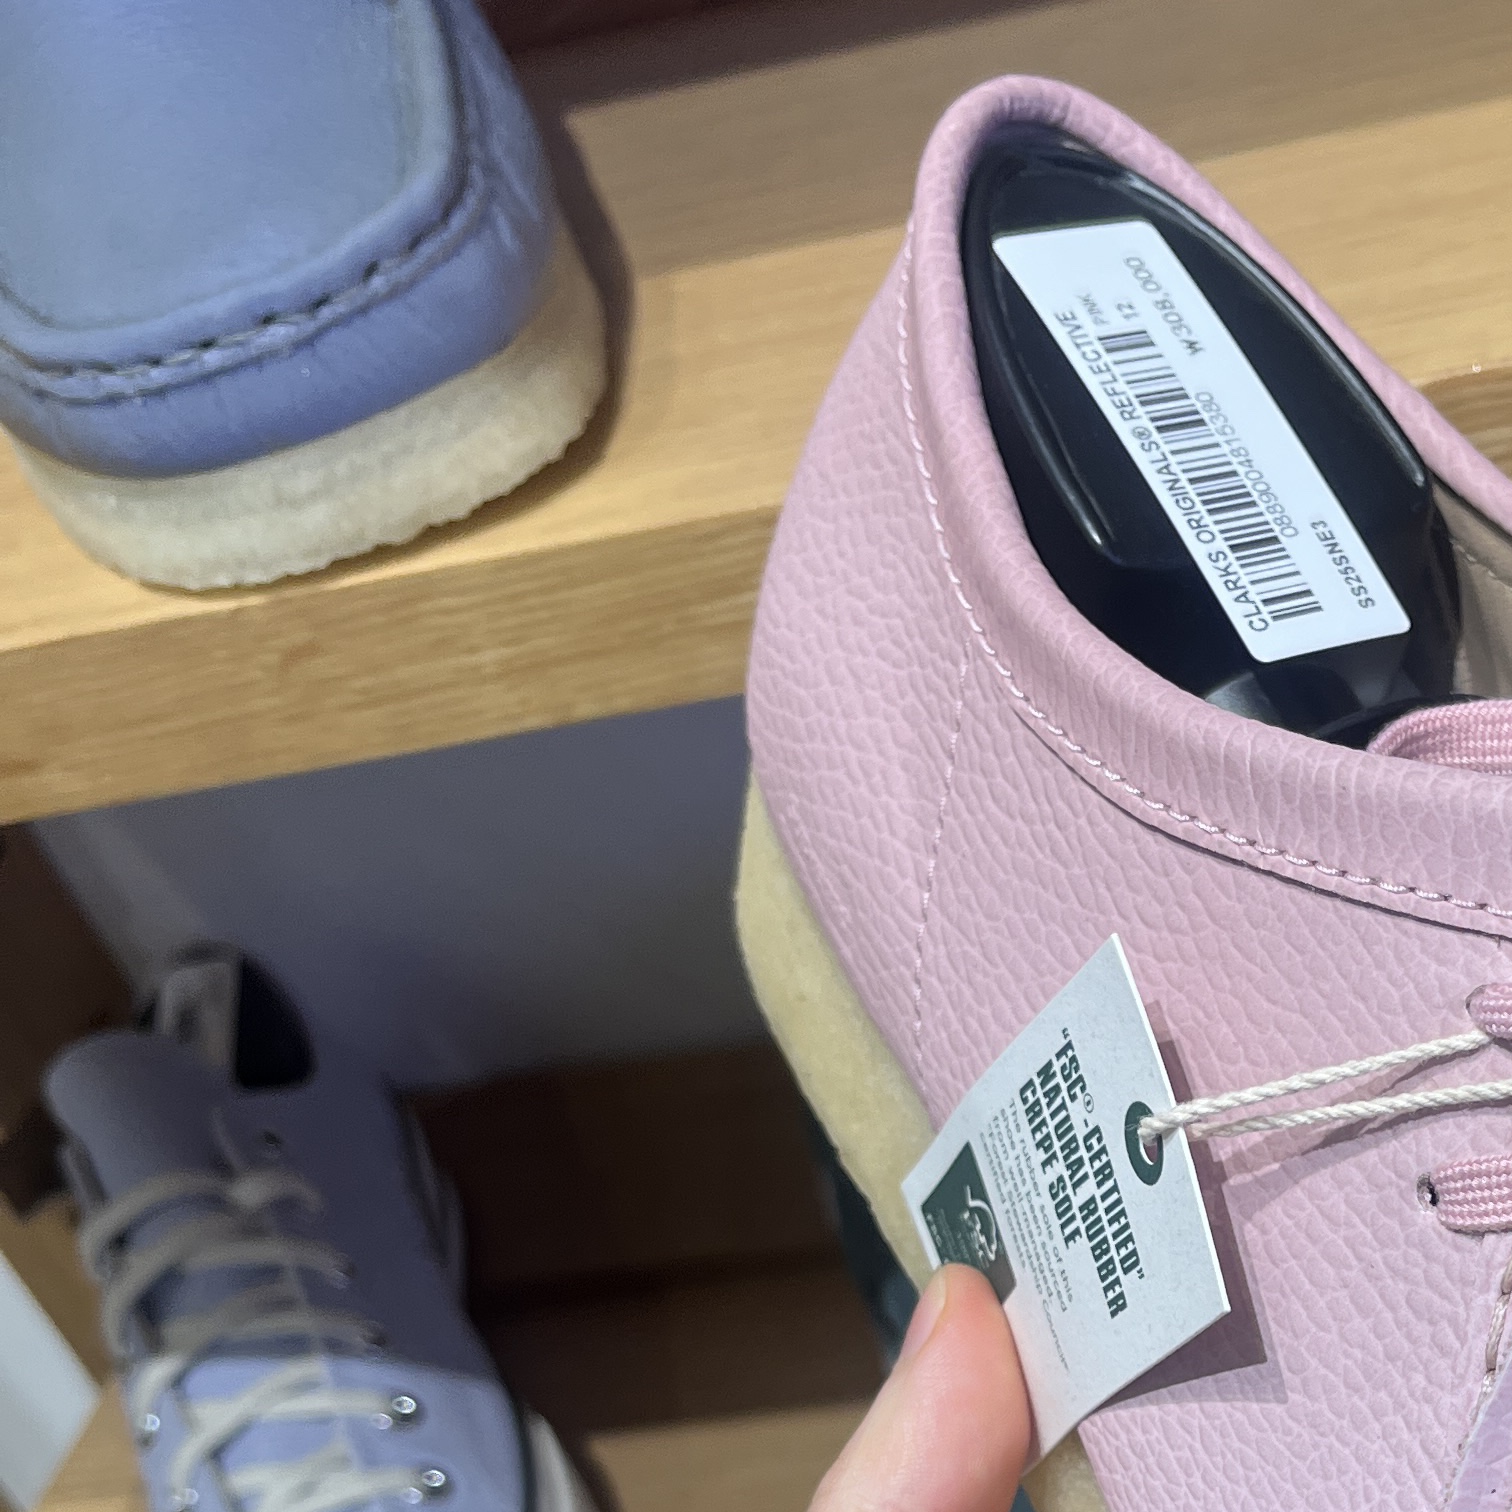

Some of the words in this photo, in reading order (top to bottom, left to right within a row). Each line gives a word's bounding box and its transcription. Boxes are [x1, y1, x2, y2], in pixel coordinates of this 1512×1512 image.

[1055, 311, 1141, 421] REFLECTIVE
[1115, 303, 1139, 320] 12
[1132, 427, 1216, 544] ORIGINALS®
[1195, 392, 1299, 538] 0889004815380
[1208, 551, 1269, 632] CLARKS
[1311, 521, 1375, 608] SS25SNE3
[993, 1116, 1009, 1160] from
[1019, 1078, 1059, 1174] CREPE
[1049, 1174, 1082, 1248] SOLE
[1037, 1059, 1089, 1196] NATURAL
[1078, 1194, 1127, 1318] RUBBER
[1000, 1108, 1016, 1150] shoe
[1015, 1154, 1026, 1186] has
[1025, 1190, 1042, 1236] been
[1041, 1241, 1067, 1312] sourced
[1007, 1190, 1042, 1294] Stewardship
[1009, 1098, 1020, 1133] The
[1020, 1139, 1041, 1197] rubber
[1040, 1204, 1053, 1240] sole
[1061, 1269, 1072, 1302] this
